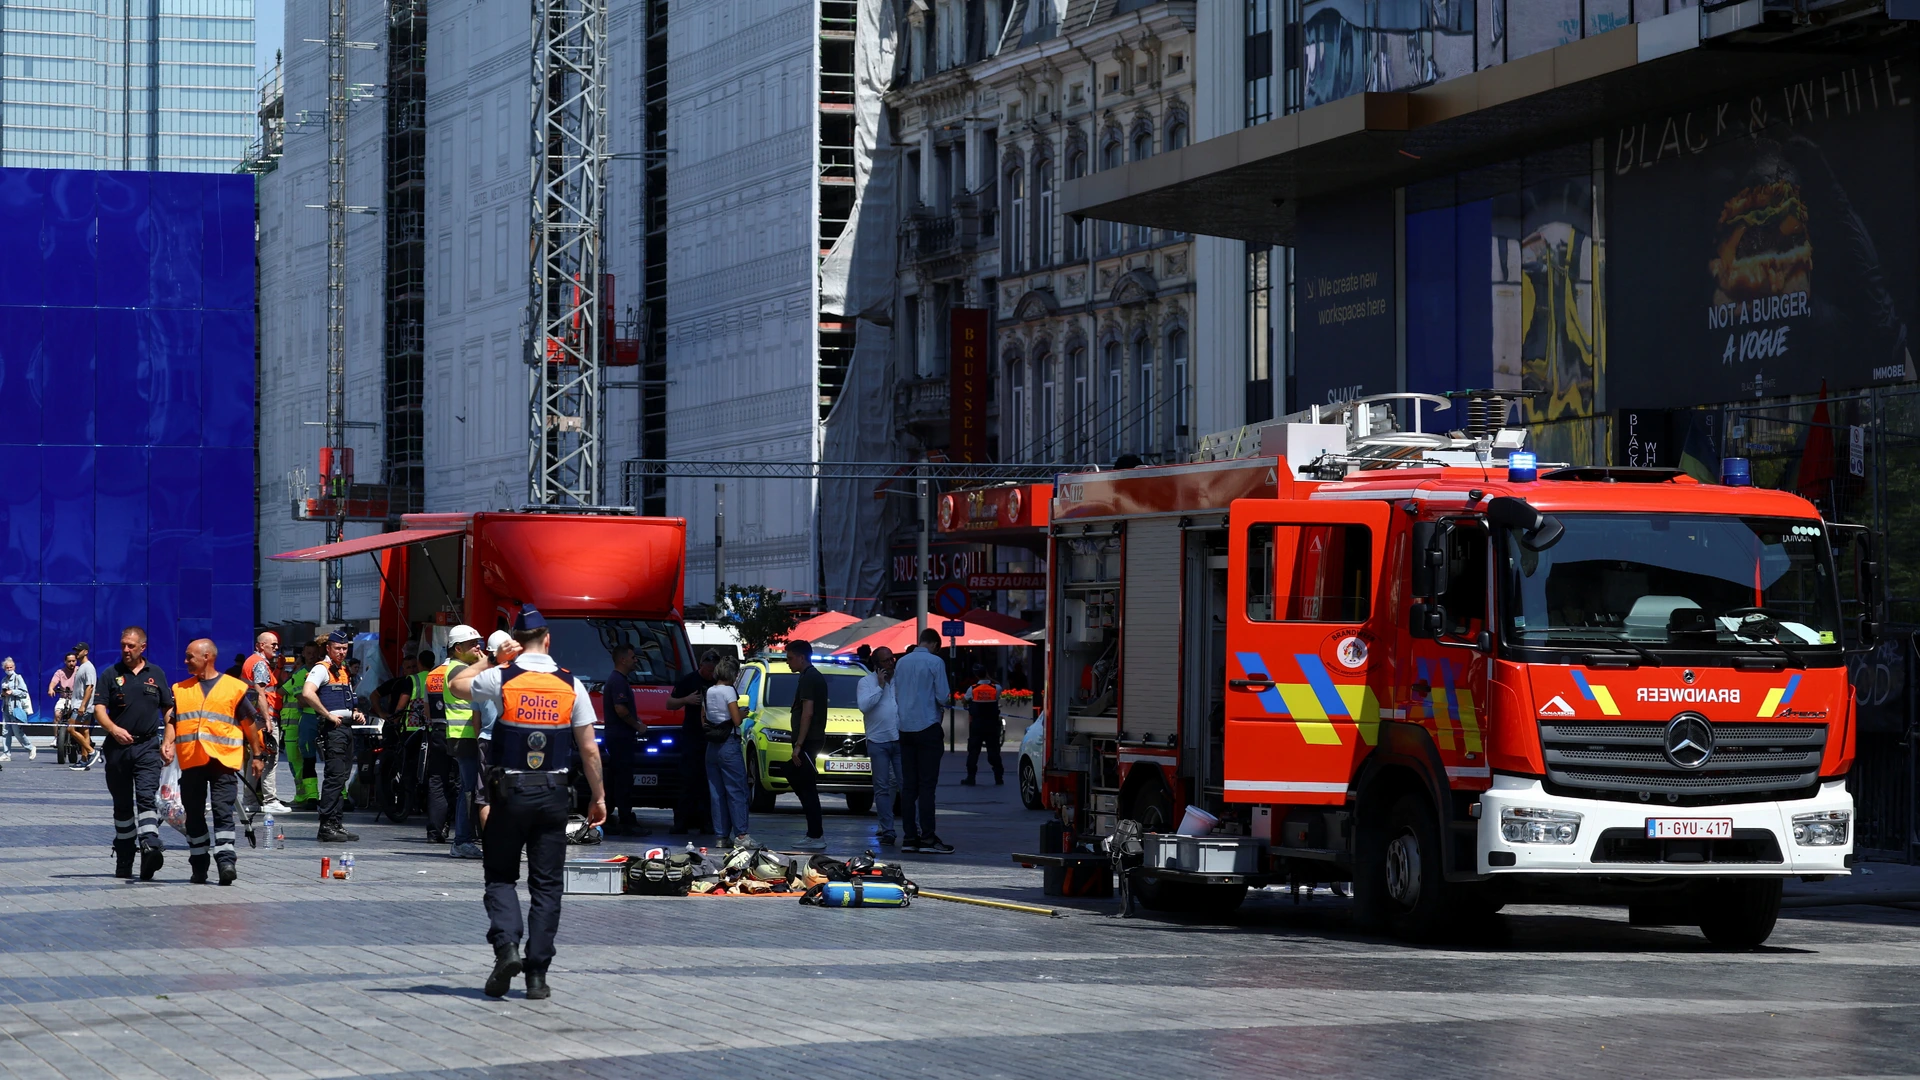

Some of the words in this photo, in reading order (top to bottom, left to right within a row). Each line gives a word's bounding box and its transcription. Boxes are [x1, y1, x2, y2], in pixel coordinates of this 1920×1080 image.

[1318, 276, 1331, 297] We
[1333, 272, 1358, 296] create
[1359, 271, 1378, 288] new
[1318, 303, 1366, 326] workspaces
[1367, 297, 1386, 317] here
[1708, 302, 1736, 330] NOT
[1739, 300, 1750, 325] A
[1753, 291, 1811, 323] BURGER,
[1722, 333, 1736, 367] A
[1738, 325, 1791, 363] VOGUE
[1873, 363, 1906, 380] IMMOBEL
[963, 327, 975, 463] BRUSSELS
[893, 553, 946, 582] BRUSELS
[521, 694, 558, 708] Police
[517, 708, 559, 721] Politie
[830, 762, 870, 770] 2-HJP-968
[1658, 822, 1729, 835] 1-GYU-417
